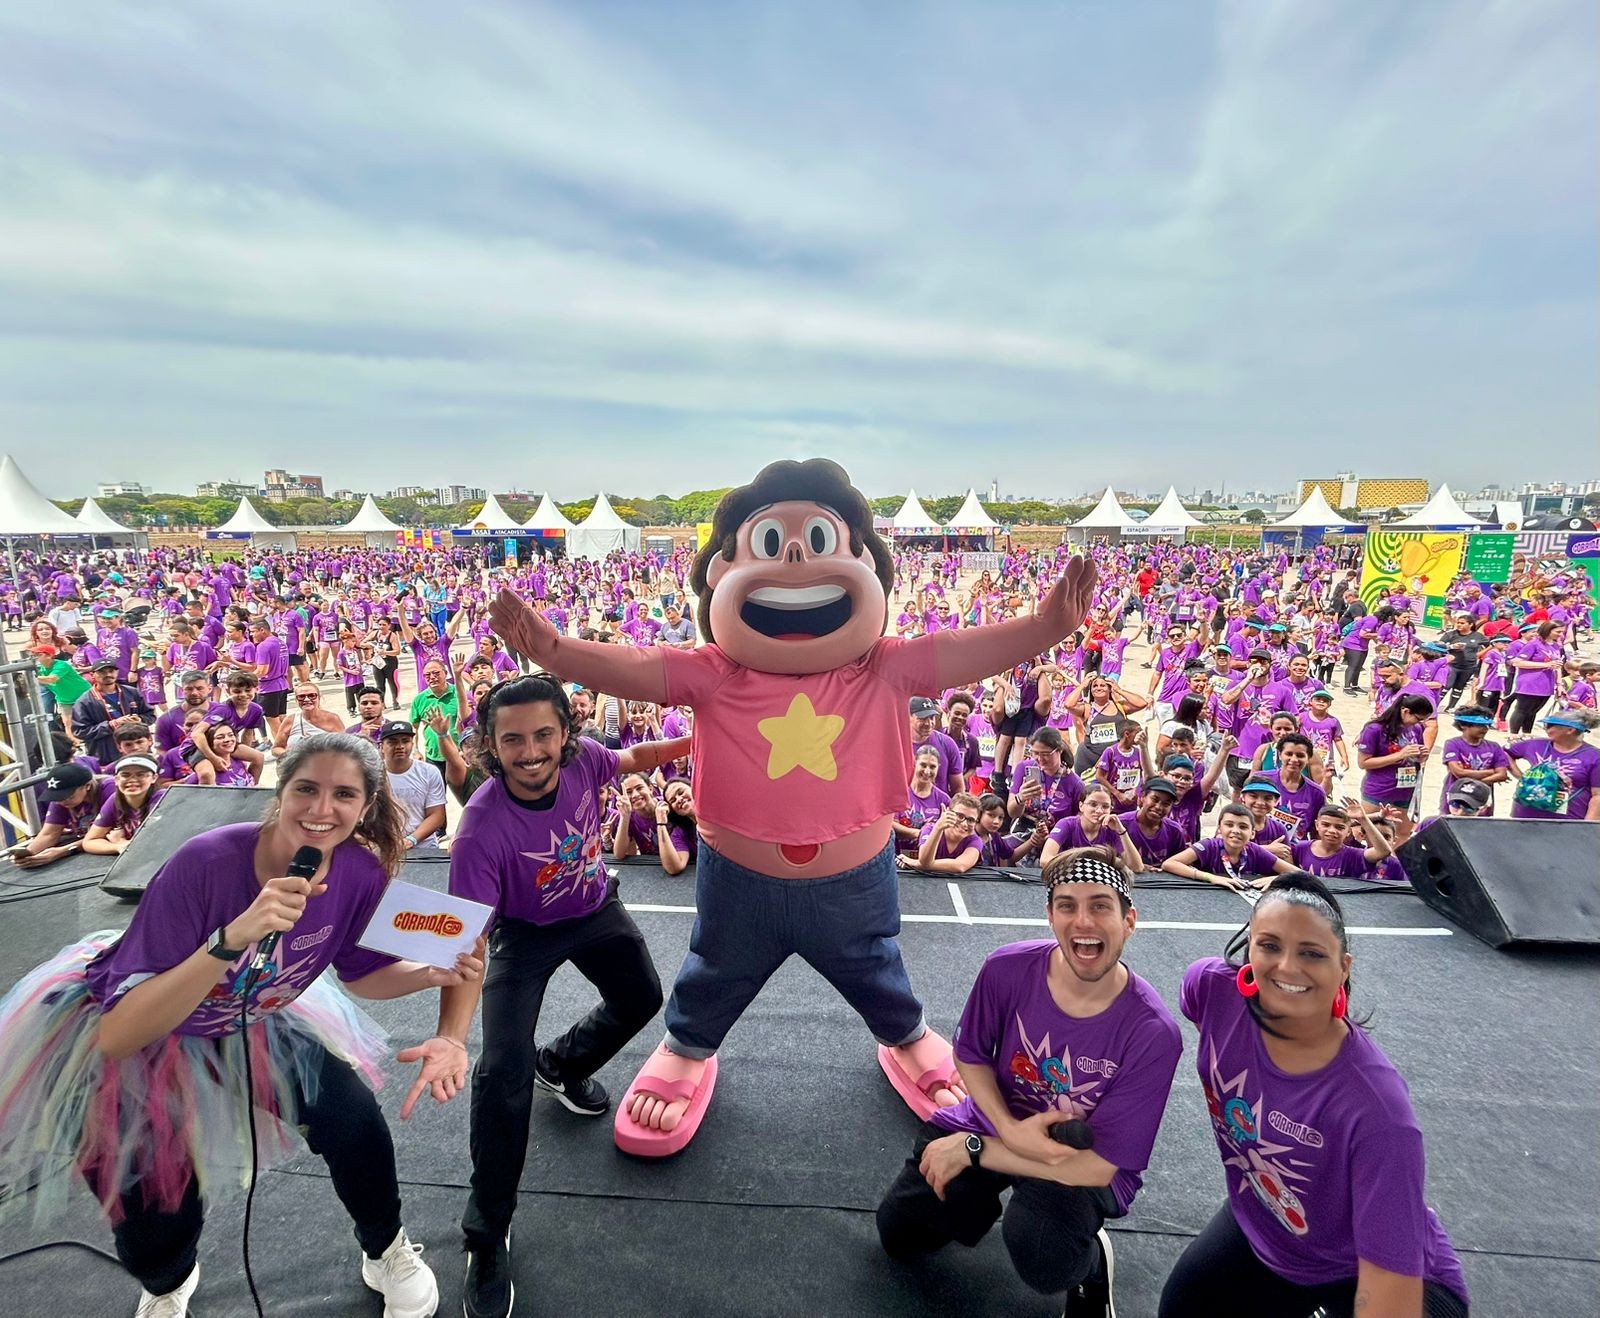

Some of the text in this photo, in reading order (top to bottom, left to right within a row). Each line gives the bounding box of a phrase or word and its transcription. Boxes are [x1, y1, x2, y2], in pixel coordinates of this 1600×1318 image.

[1093, 730, 1115, 738] 2402
[394, 912, 447, 935] CORRIDA
[1270, 1111, 1308, 1143] CORRIDA
